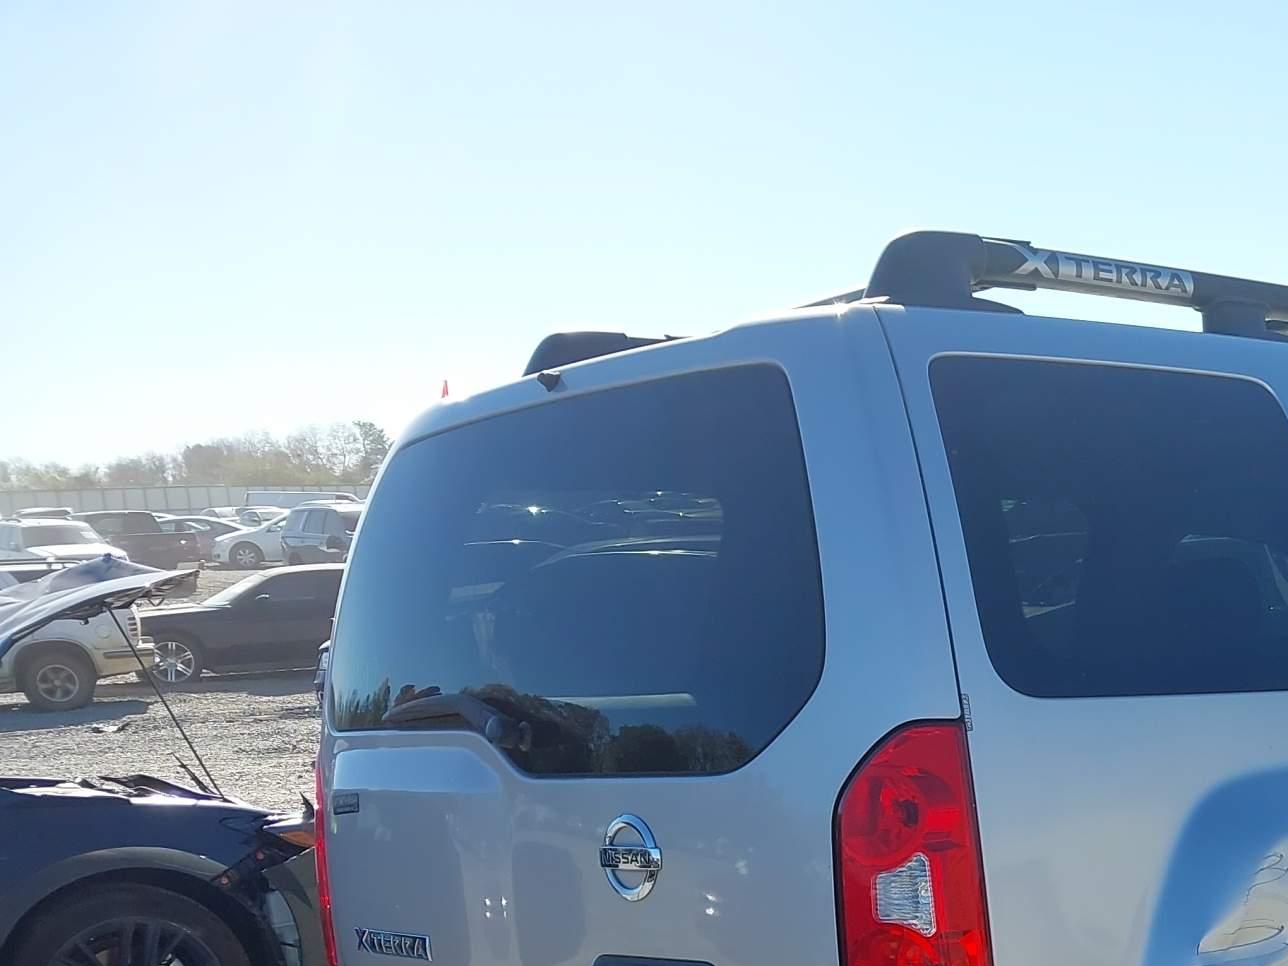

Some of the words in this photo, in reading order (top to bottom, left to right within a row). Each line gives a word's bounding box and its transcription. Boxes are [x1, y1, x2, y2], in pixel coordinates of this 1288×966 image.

[1013, 245, 1191, 295] XTERRA
[601, 850, 651, 865] NISSAN
[354, 927, 431, 960] XTERRA
